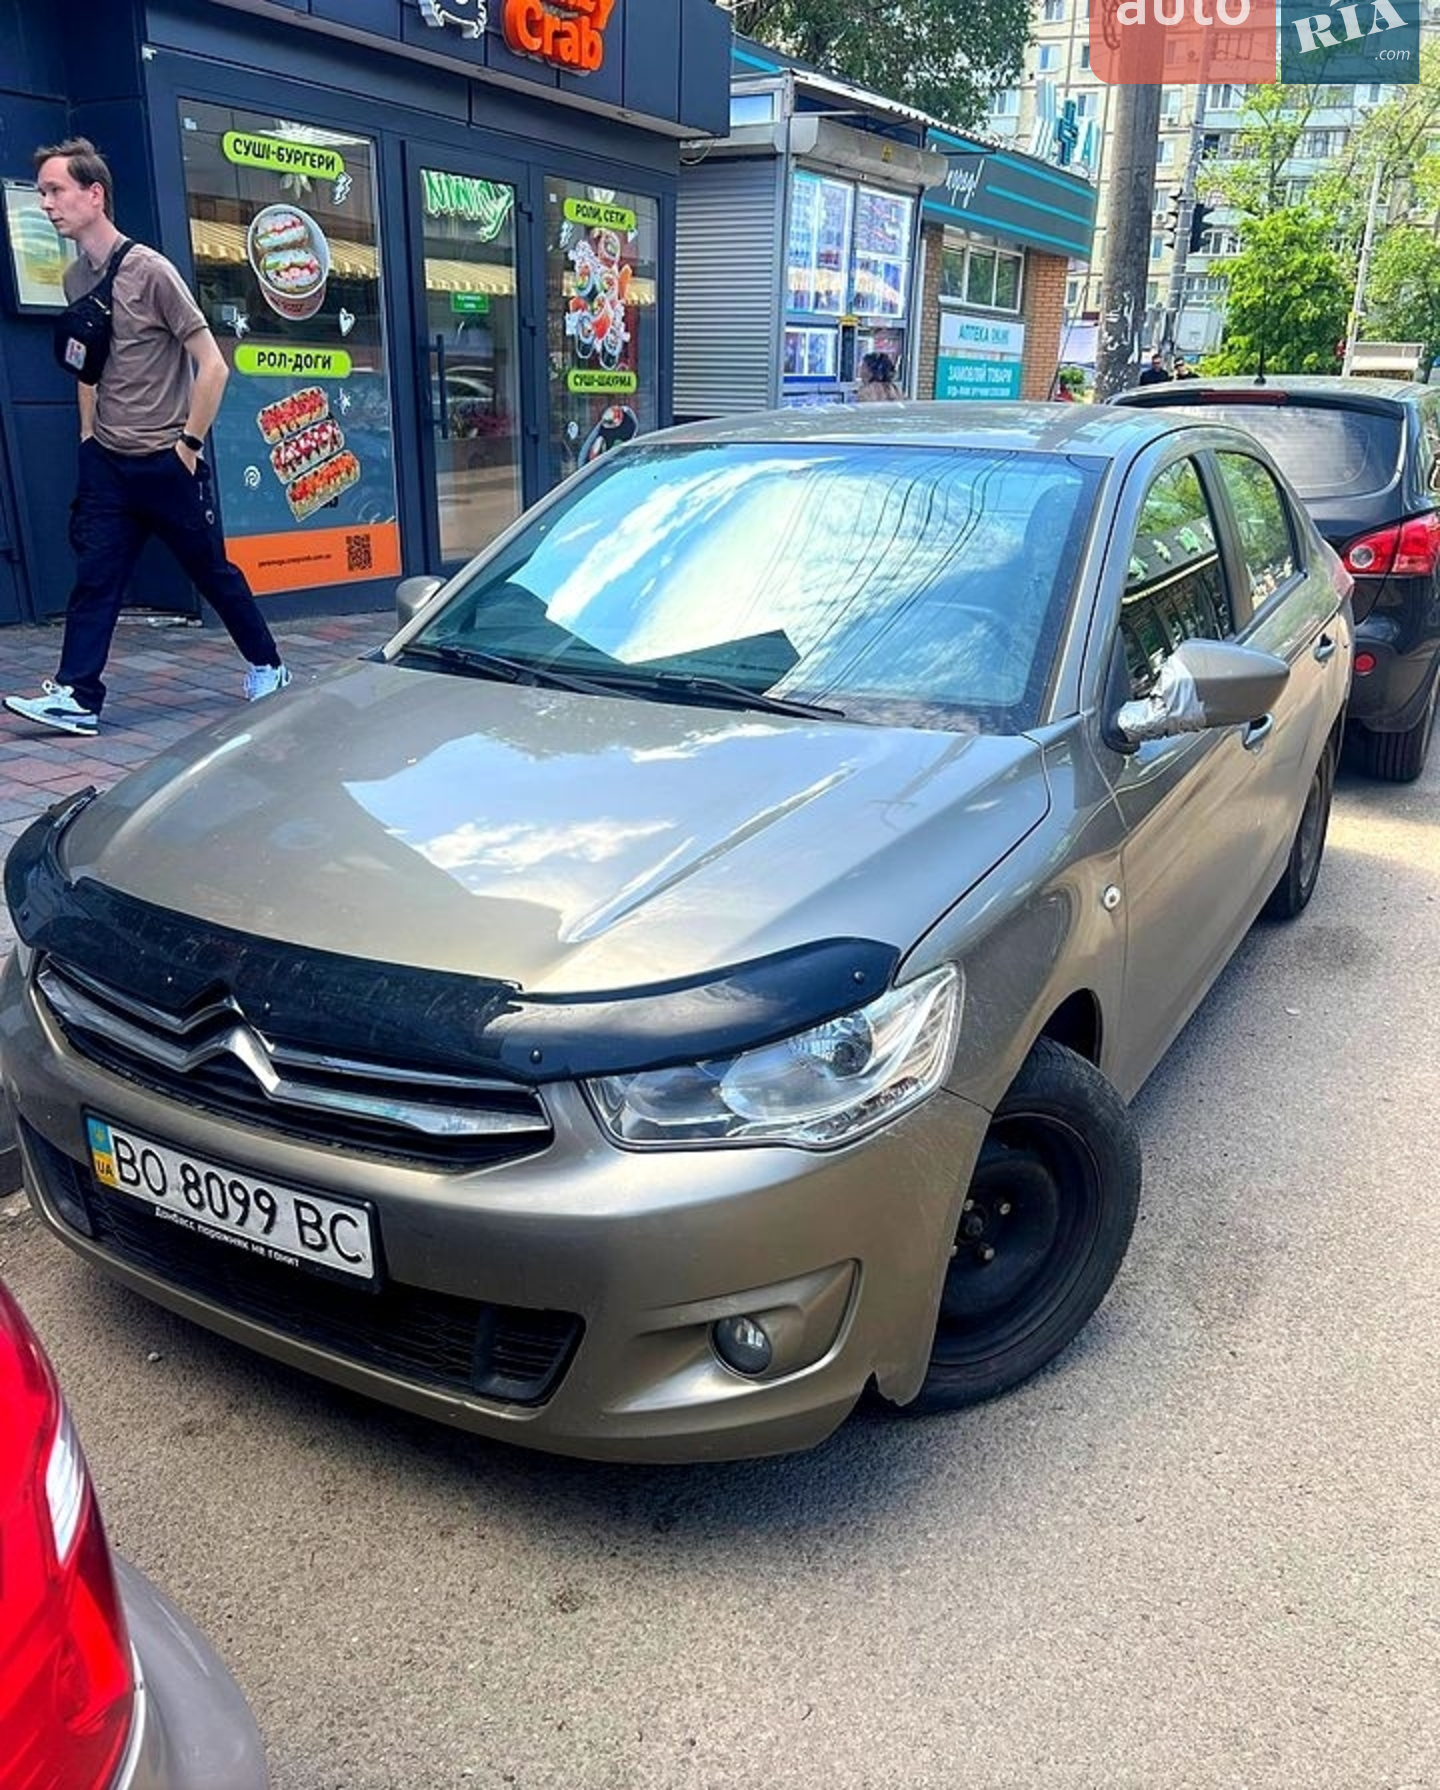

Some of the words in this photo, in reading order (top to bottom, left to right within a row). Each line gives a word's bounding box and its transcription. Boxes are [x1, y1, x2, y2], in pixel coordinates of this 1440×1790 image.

[505, 0, 604, 71] Crab
[232, 138, 335, 172] СУШІ-БУРГЕРИ
[603, 209, 627, 224] СЕТИ
[958, 323, 989, 343] АПТЕКА
[257, 351, 332, 373] РОЛ-ДОГИ
[96, 1159, 115, 1178] UA
[112, 1134, 168, 1198] BO
[179, 1162, 278, 1236] 8099
[293, 1197, 364, 1265] BC
